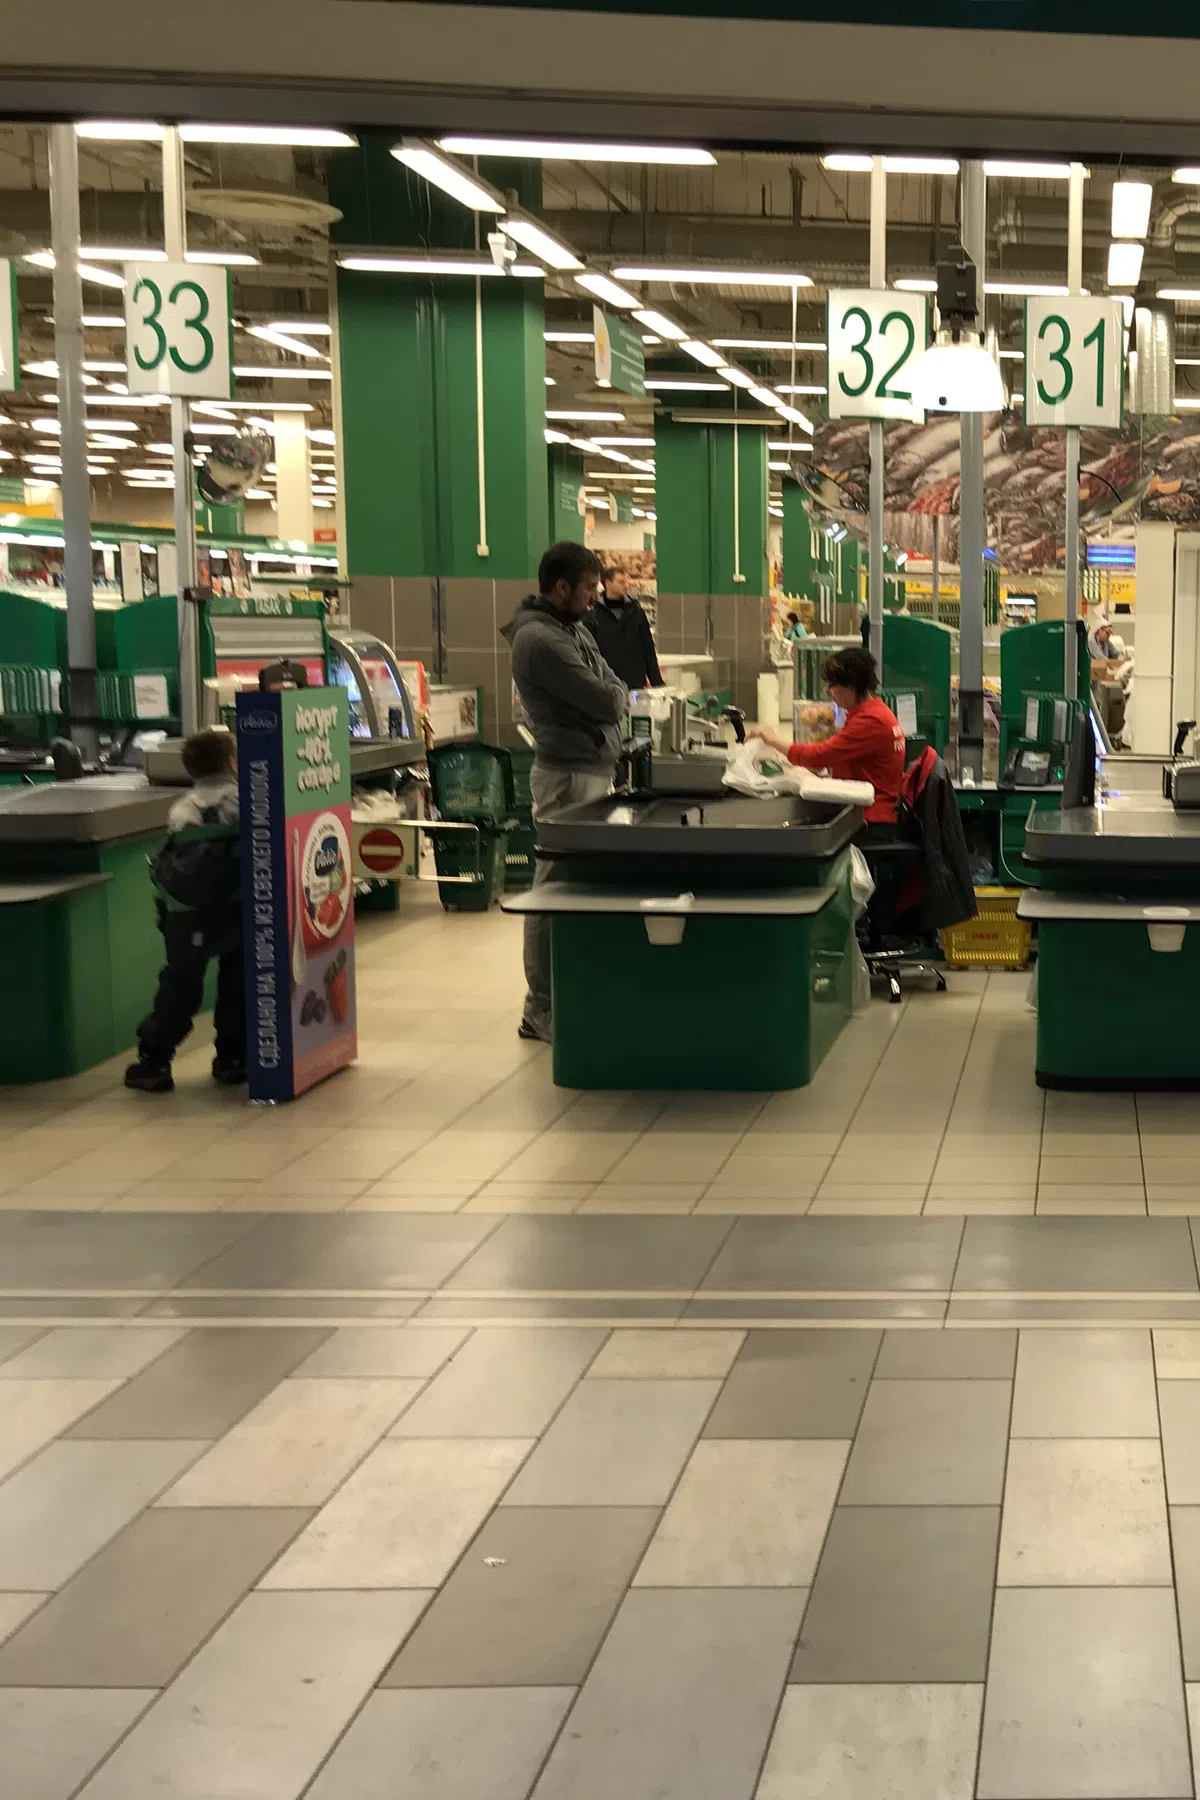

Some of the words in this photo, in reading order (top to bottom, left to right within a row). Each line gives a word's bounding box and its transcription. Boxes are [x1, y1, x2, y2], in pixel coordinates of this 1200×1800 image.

[133, 278, 214, 374] 33
[838, 307, 914, 400] 32
[1037, 315, 1105, 407] 31
[249, 759, 271, 827] МОЛОКА
[252, 828, 273, 900] СВЕЖЕГО
[254, 903, 274, 925] ИЗ
[255, 927, 275, 969] 100%
[256, 972, 276, 994] НА
[258, 997, 281, 1069] СДЕЛАНО
